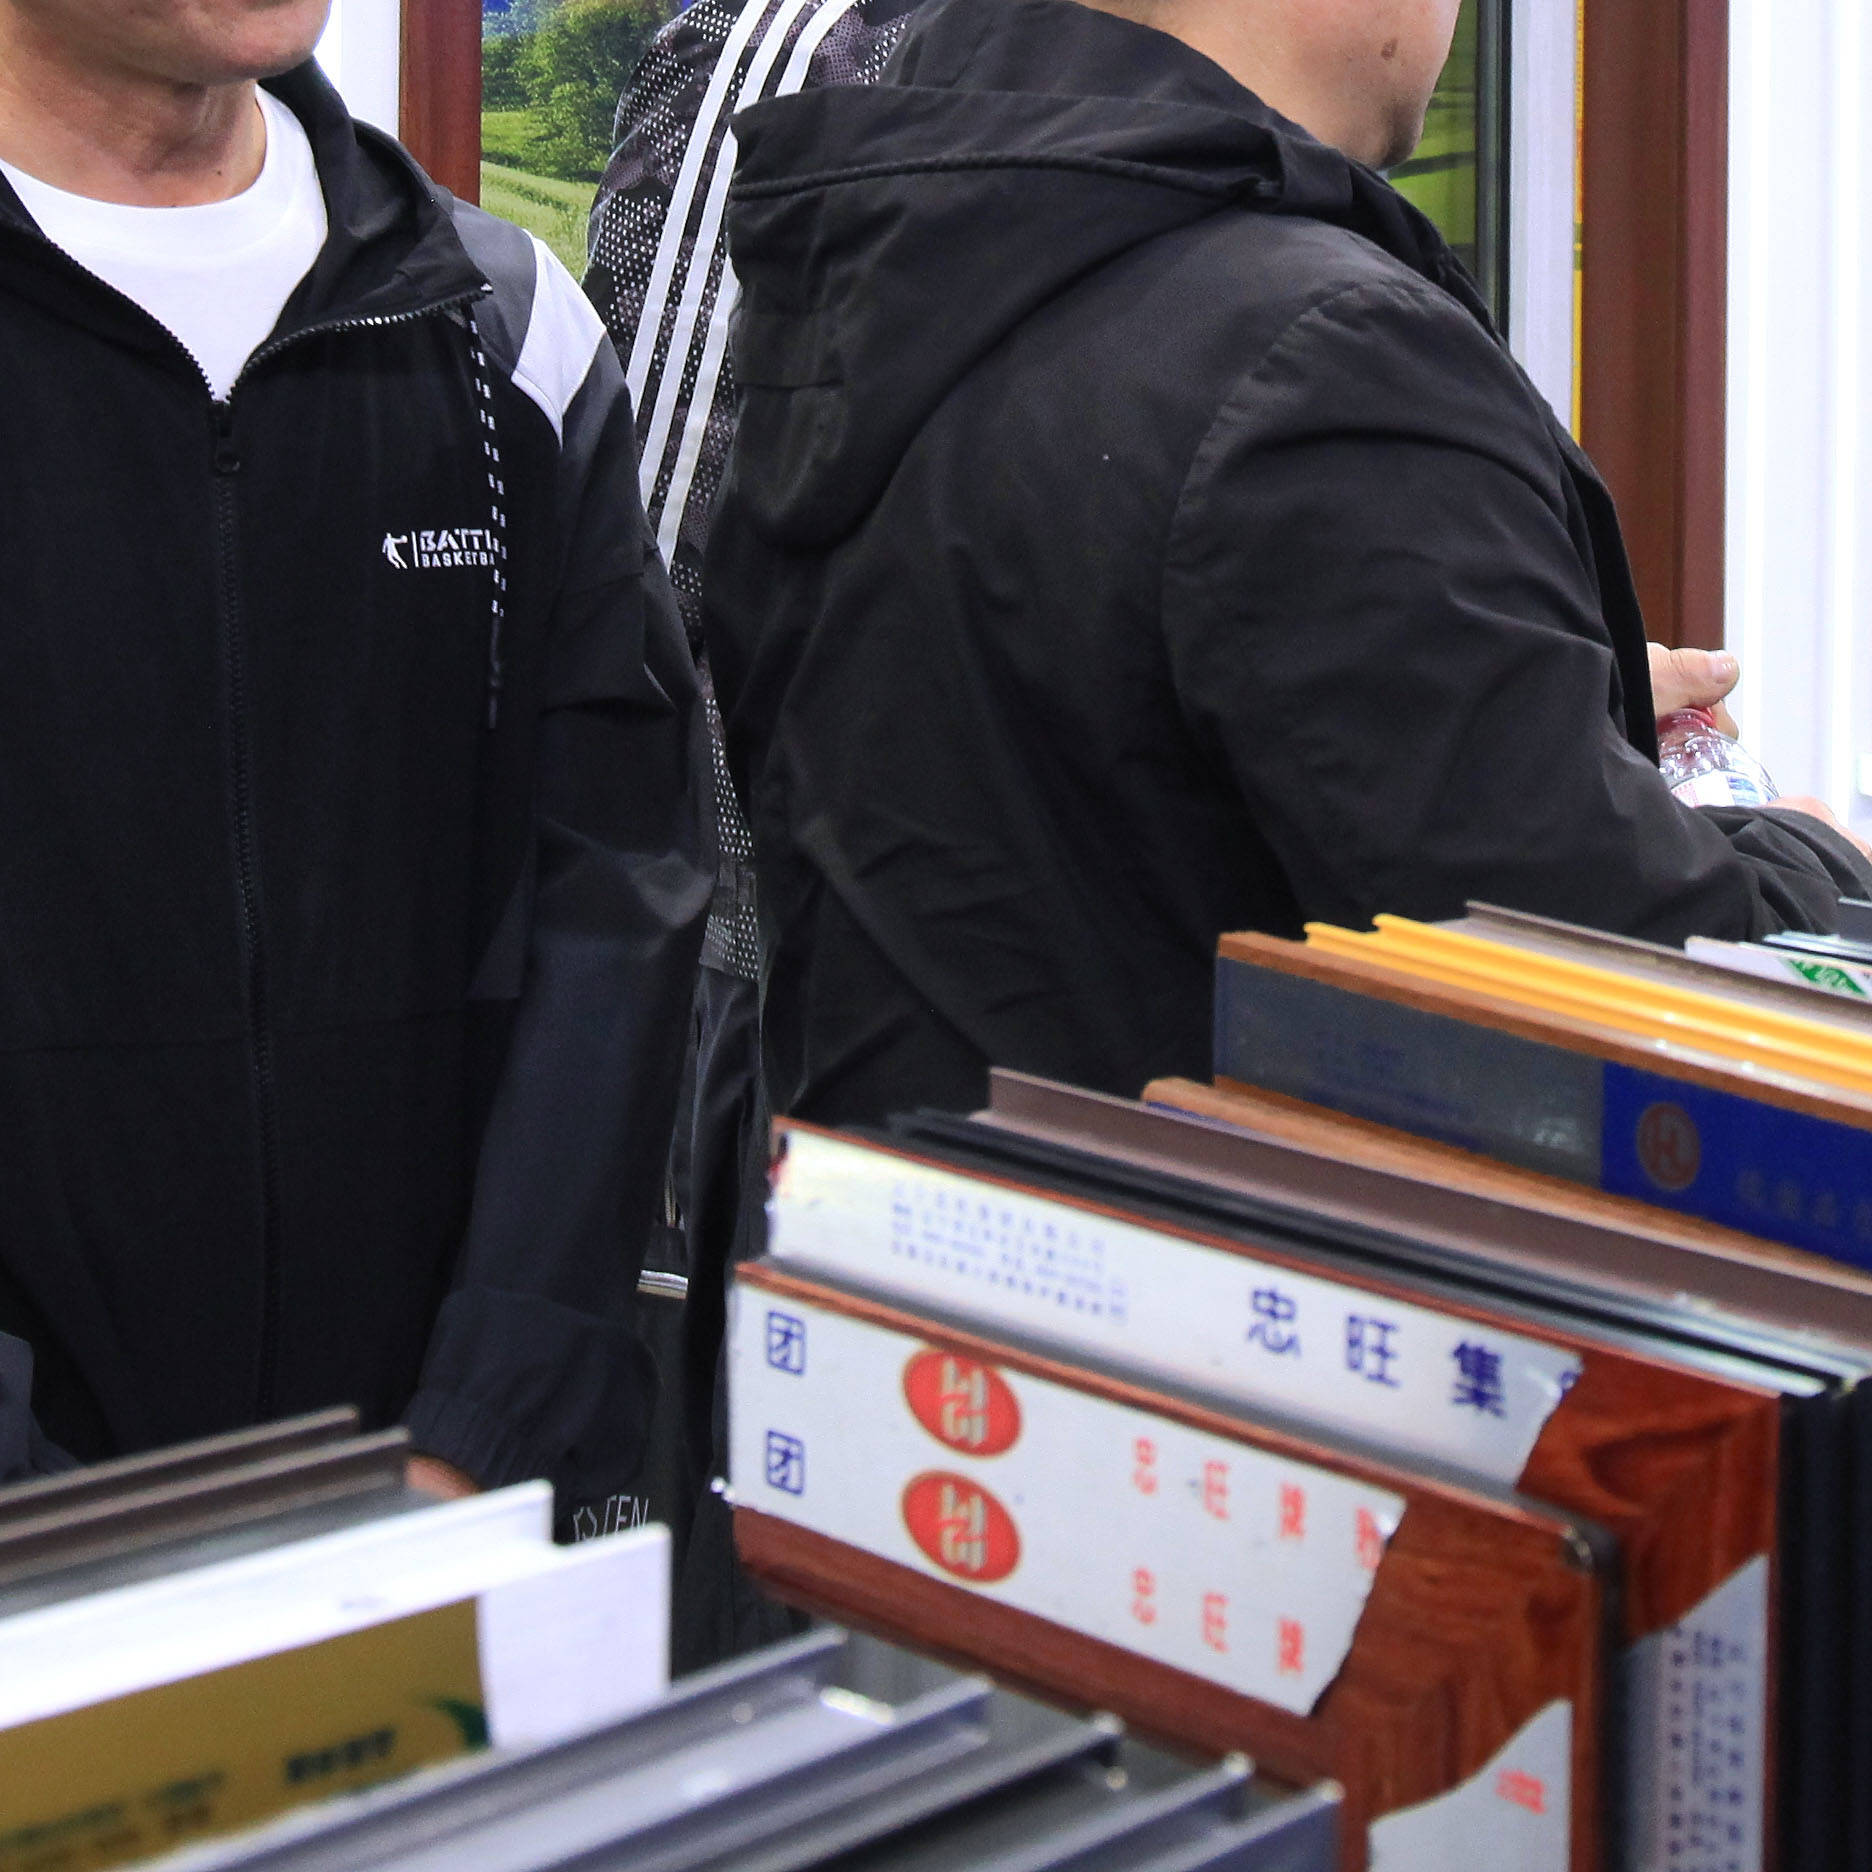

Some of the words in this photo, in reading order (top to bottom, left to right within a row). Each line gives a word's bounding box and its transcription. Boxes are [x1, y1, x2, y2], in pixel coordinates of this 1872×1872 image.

[765, 1310, 807, 1377] 团
[1246, 1284, 1580, 1421] 忠旺集
[765, 1429, 807, 1497] 团
